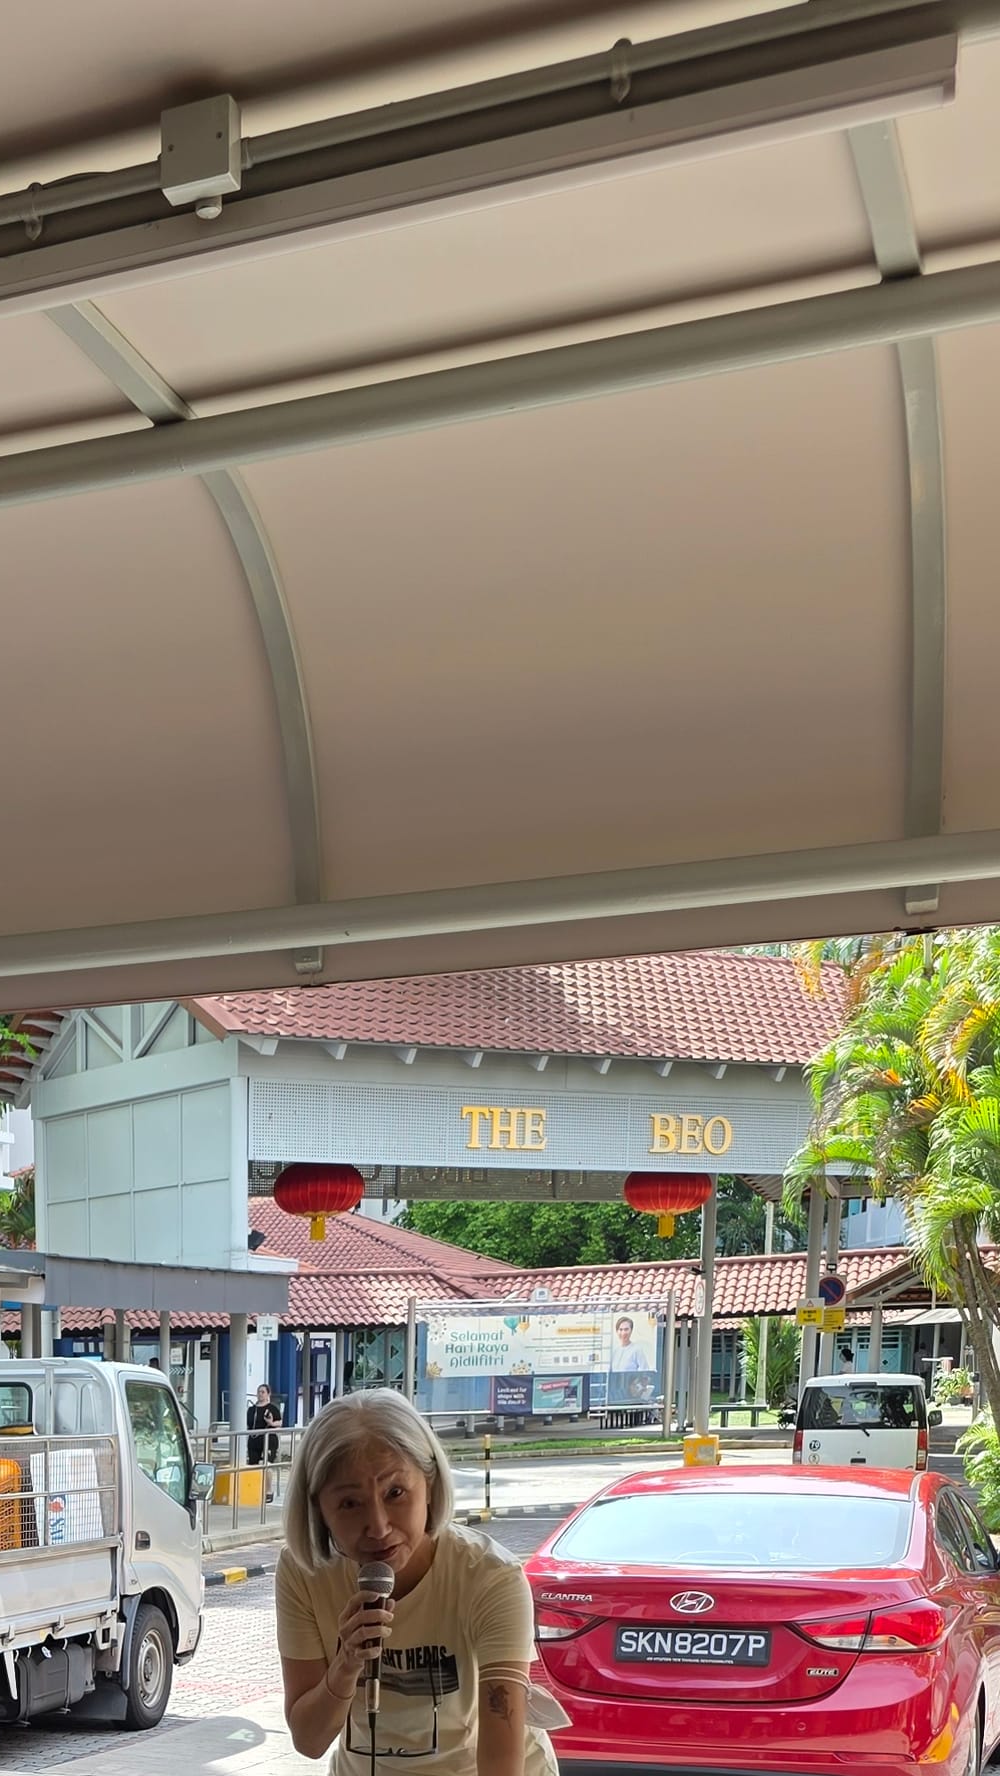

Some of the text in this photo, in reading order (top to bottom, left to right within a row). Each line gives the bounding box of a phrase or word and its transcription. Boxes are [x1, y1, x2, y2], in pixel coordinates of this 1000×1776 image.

[461, 1106, 732, 1155] THE BEO
[450, 1330, 504, 1342] Selamat
[445, 1343, 509, 1356] Hari Raya
[450, 1354, 504, 1368] Aidilfitri
[541, 1592, 593, 1602] ELANTRA
[620, 1631, 766, 1657] SKN8207P
[406, 1646, 448, 1670] HEADS
